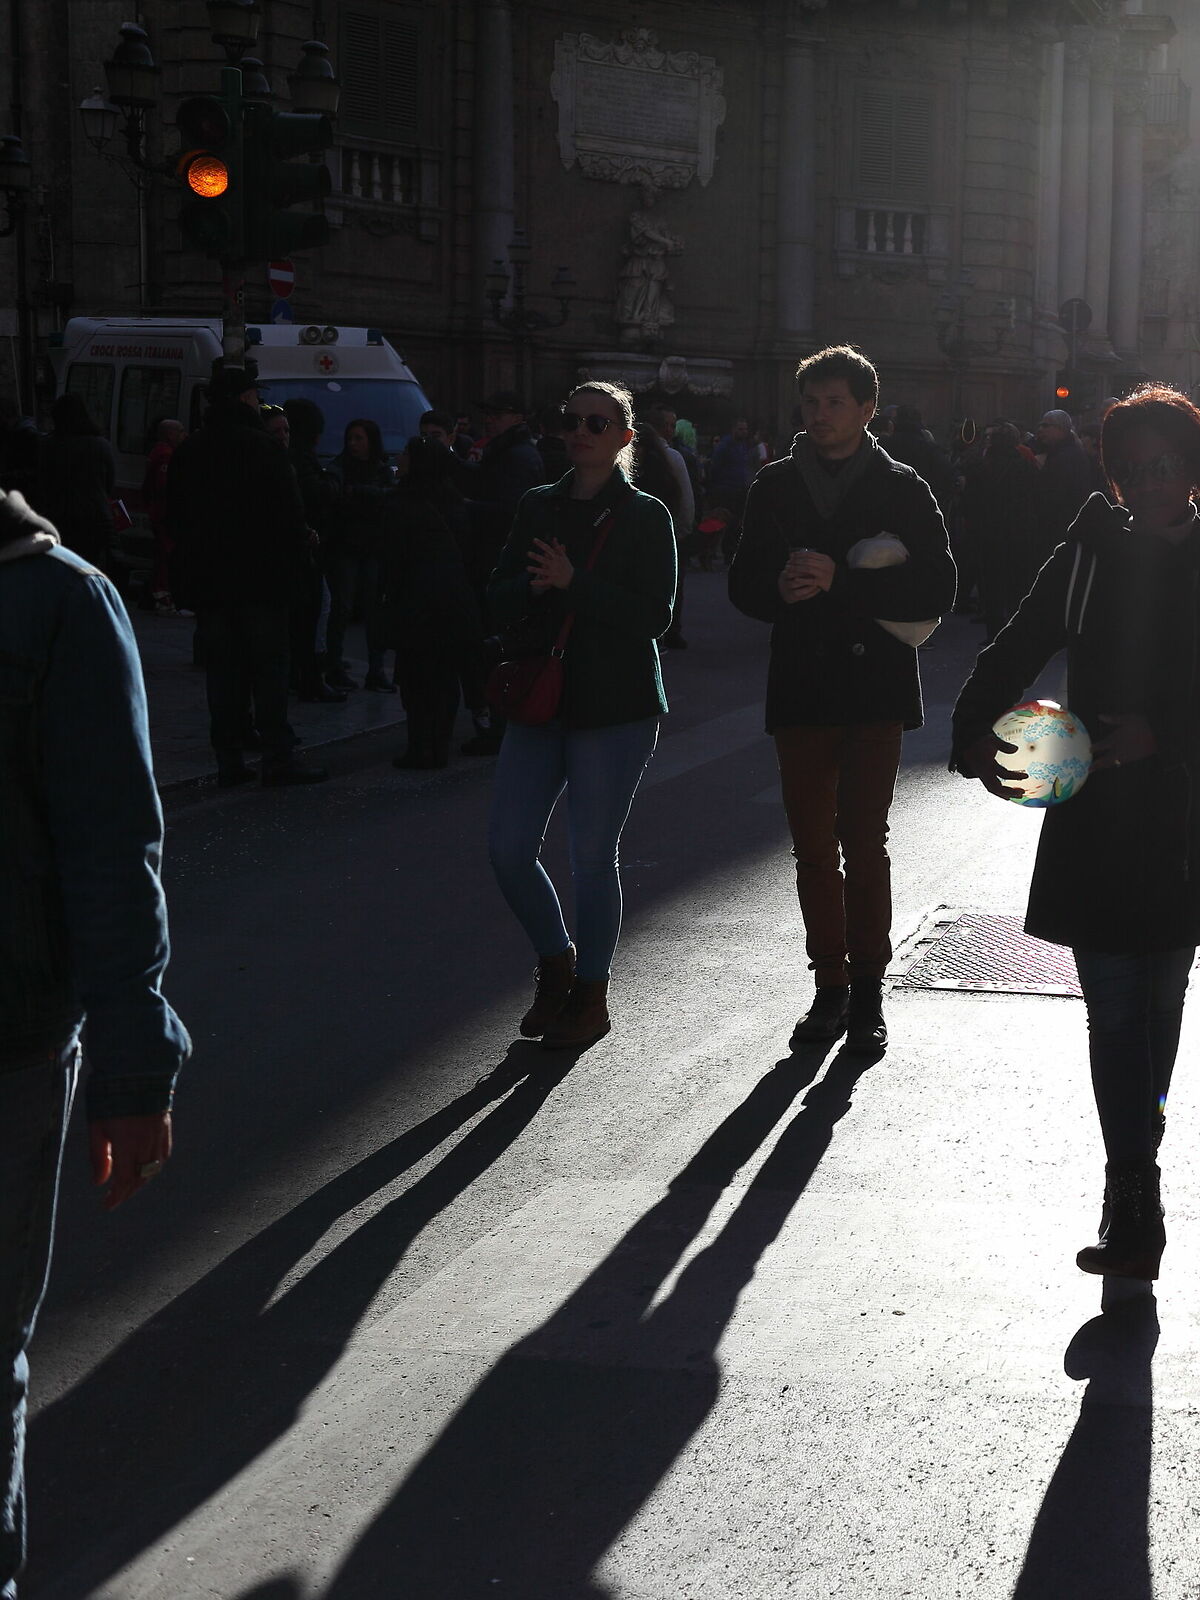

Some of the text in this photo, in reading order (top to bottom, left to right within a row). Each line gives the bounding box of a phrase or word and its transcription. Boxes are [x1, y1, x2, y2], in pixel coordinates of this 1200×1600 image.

[90, 344, 184, 360] CROCE ROSSA ITALIANA
